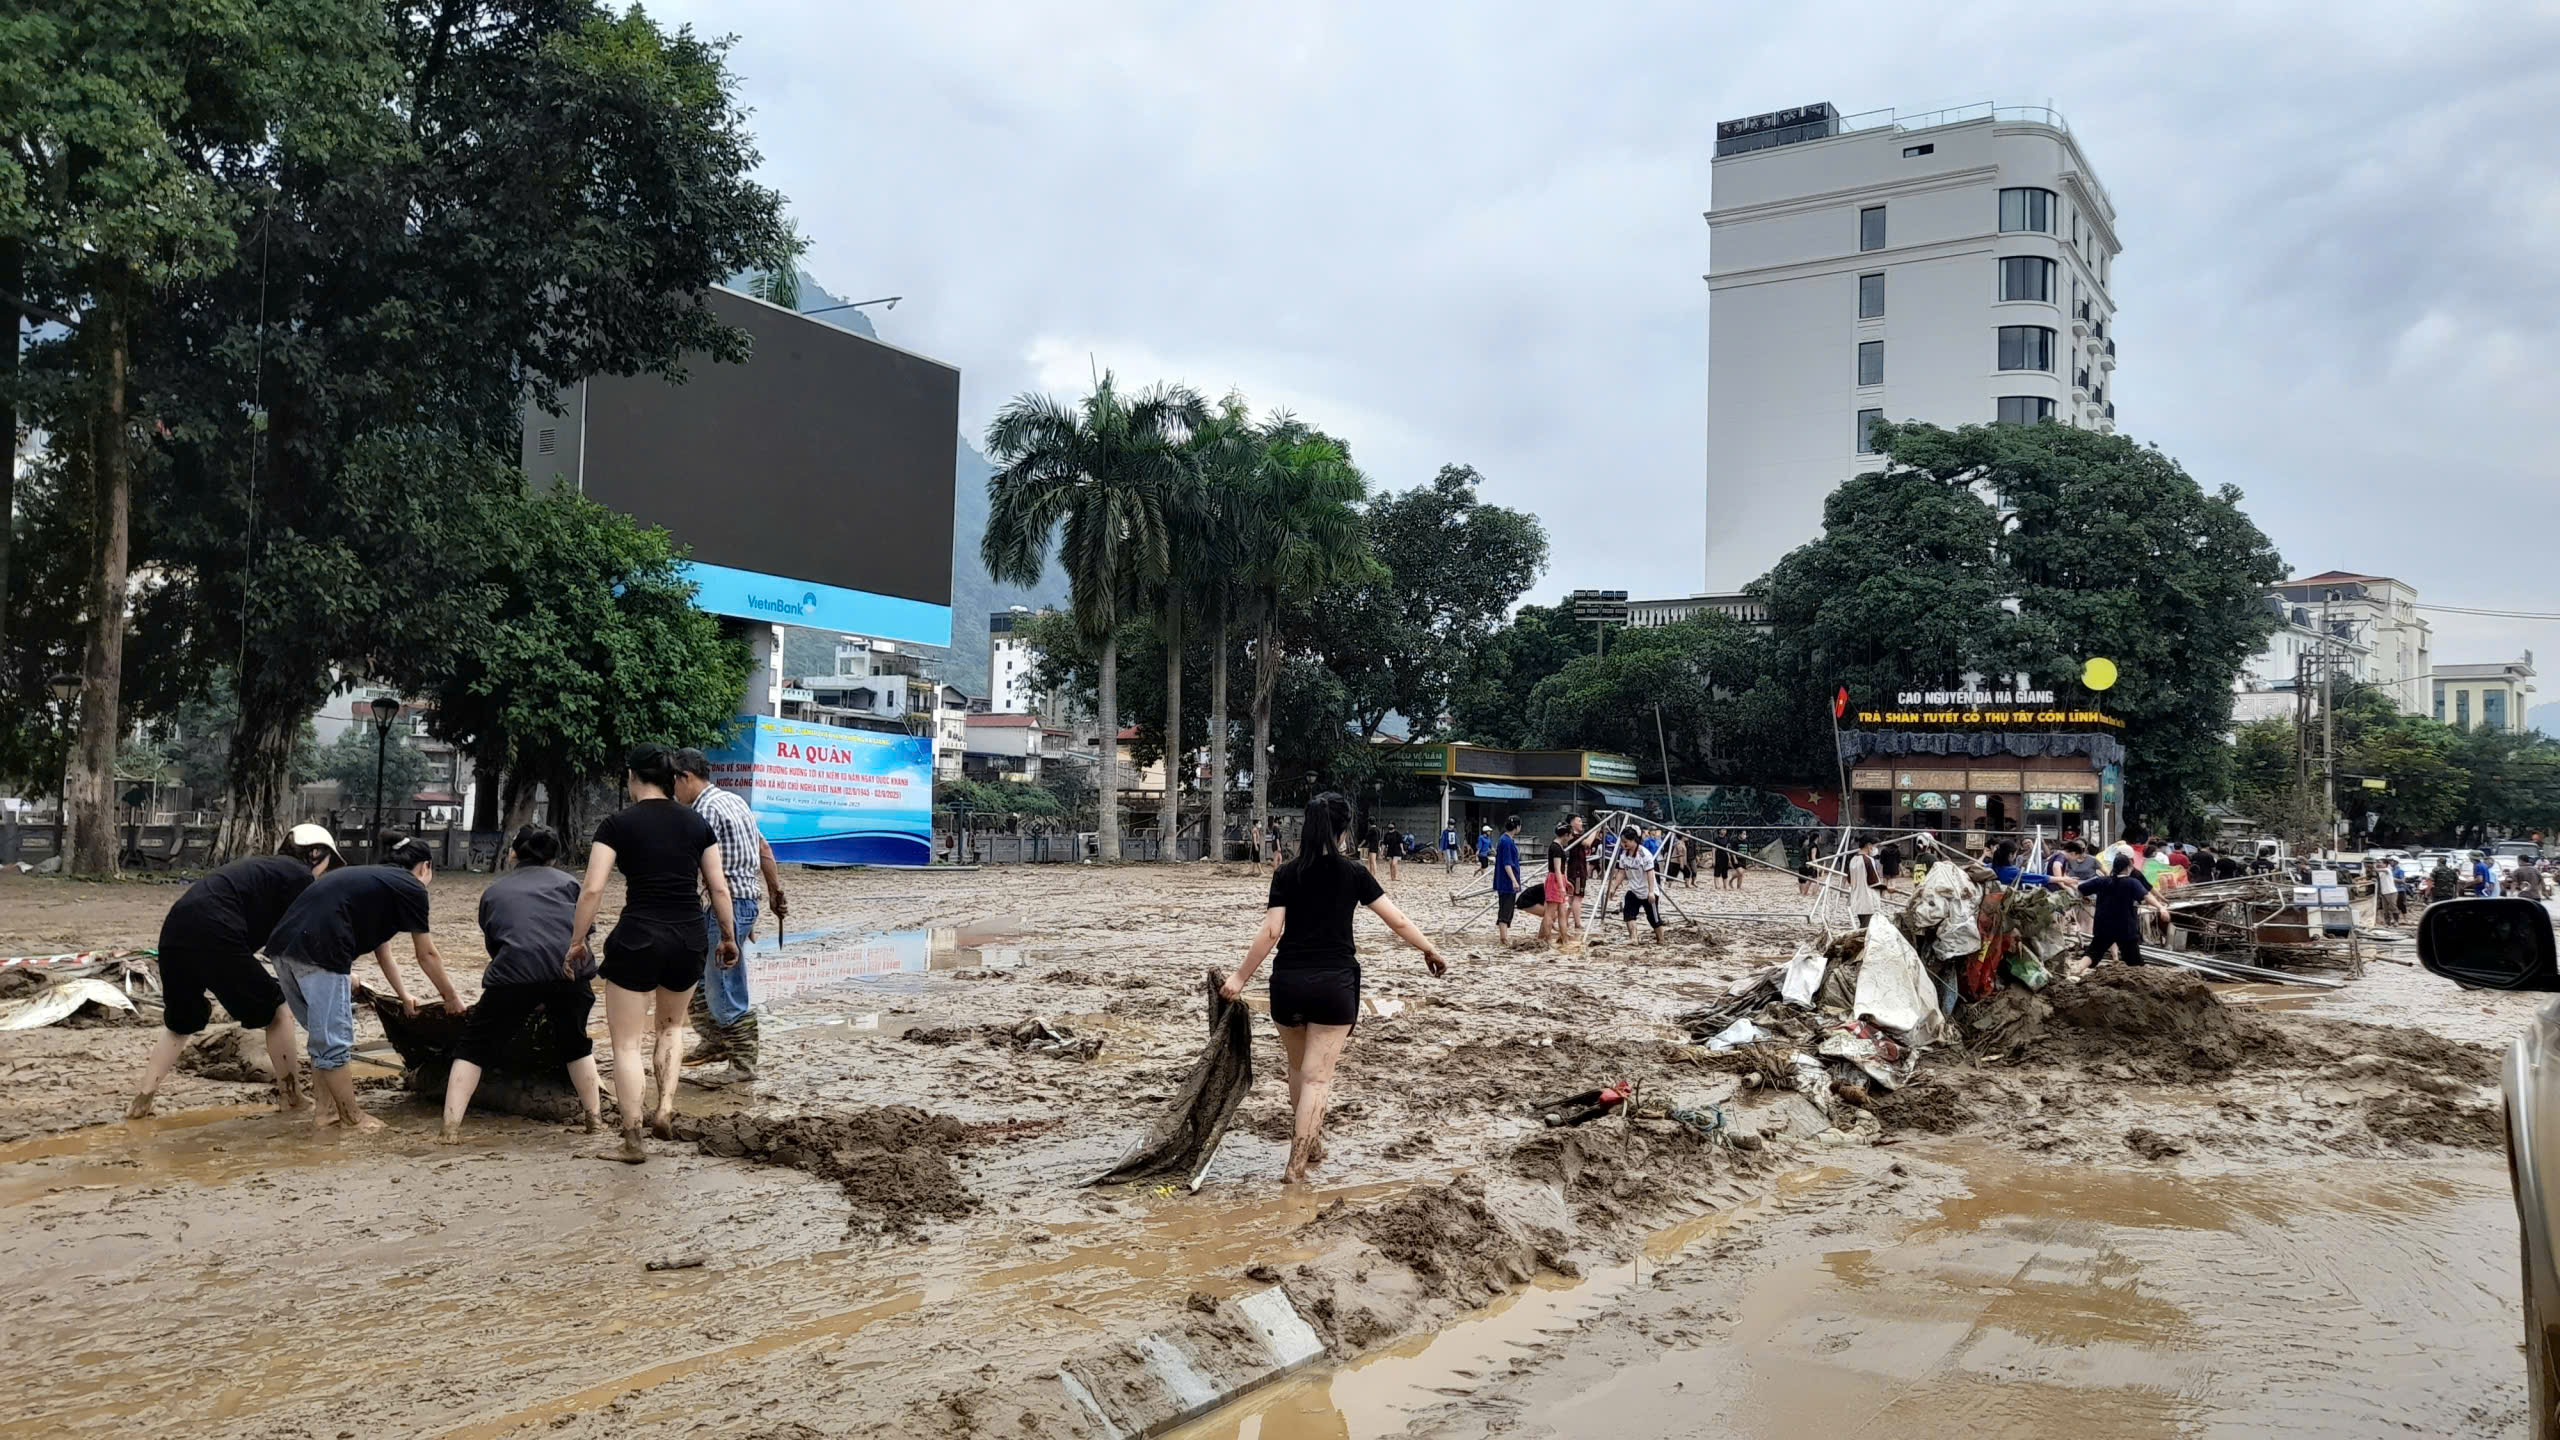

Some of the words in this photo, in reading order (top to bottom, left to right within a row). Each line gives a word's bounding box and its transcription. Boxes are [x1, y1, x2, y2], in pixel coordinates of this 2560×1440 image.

[747, 594, 804, 616] VietinBank
[1898, 692, 1921, 705] CAO
[1924, 689, 1972, 705] NGUYÊN
[1975, 688, 1992, 704] ĐÁ
[1995, 688, 2012, 704] HÀ
[2015, 690, 2054, 704] GIANG
[1858, 709, 1881, 722] TRÀ
[1885, 712, 1919, 722] SHAN
[1923, 707, 1960, 722] TUYẾT
[1984, 712, 2009, 725] THỤ
[2012, 709, 2034, 722] TÂY
[2037, 709, 2065, 722] CÔN
[2068, 709, 2098, 722] LĨNH
[777, 742, 800, 759] RA
[806, 744, 851, 764] QUÂN
[736, 763, 752, 773] SINH
[735, 776, 752, 789] CỘNG
[830, 785, 842, 795] NAM
